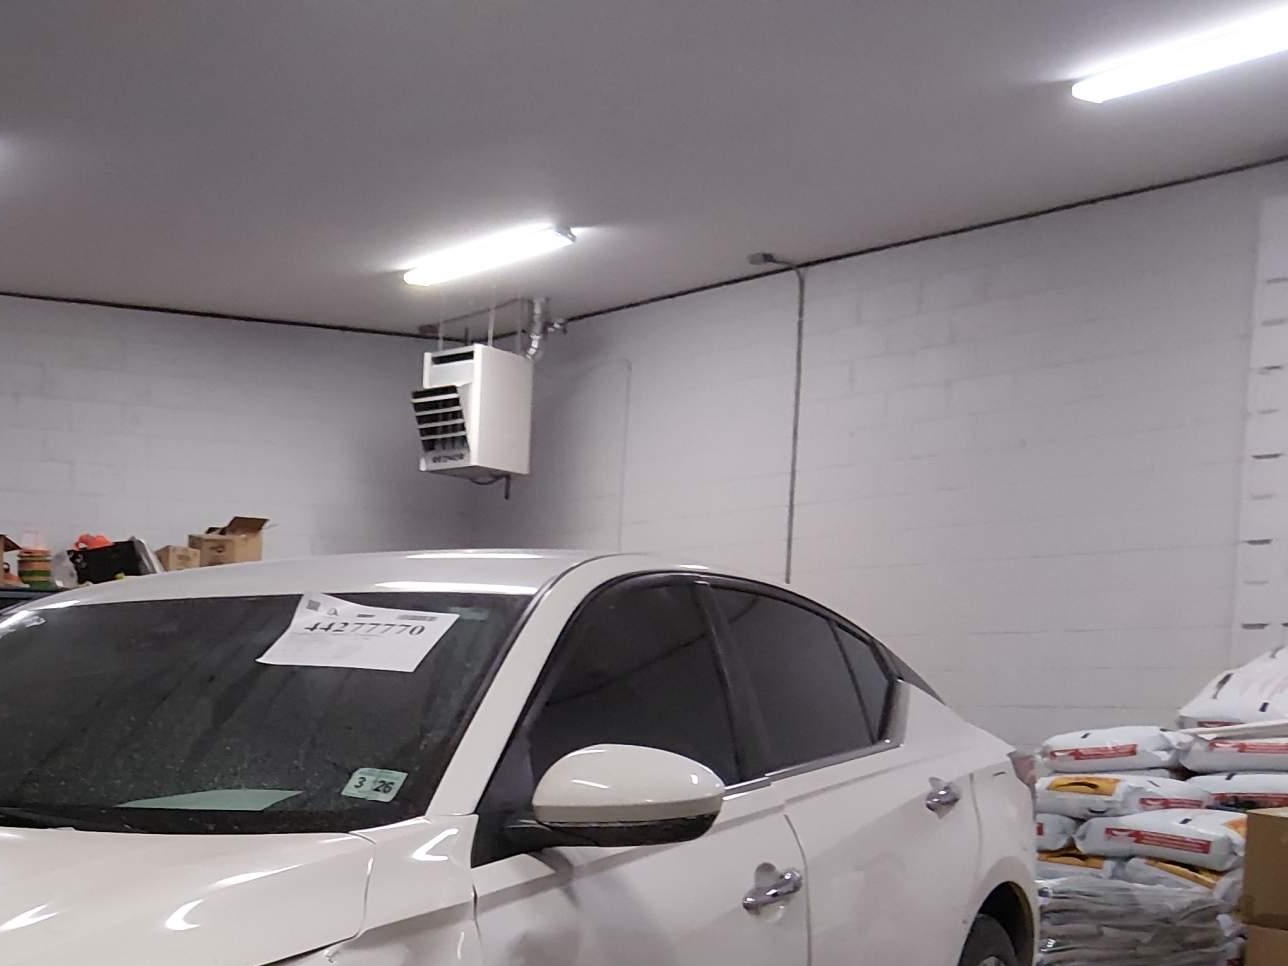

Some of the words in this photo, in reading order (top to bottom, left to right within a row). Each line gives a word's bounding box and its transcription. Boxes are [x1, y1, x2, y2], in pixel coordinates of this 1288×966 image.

[304, 622, 424, 636] 44277770
[354, 776, 367, 788] 3
[373, 780, 395, 794] 26
